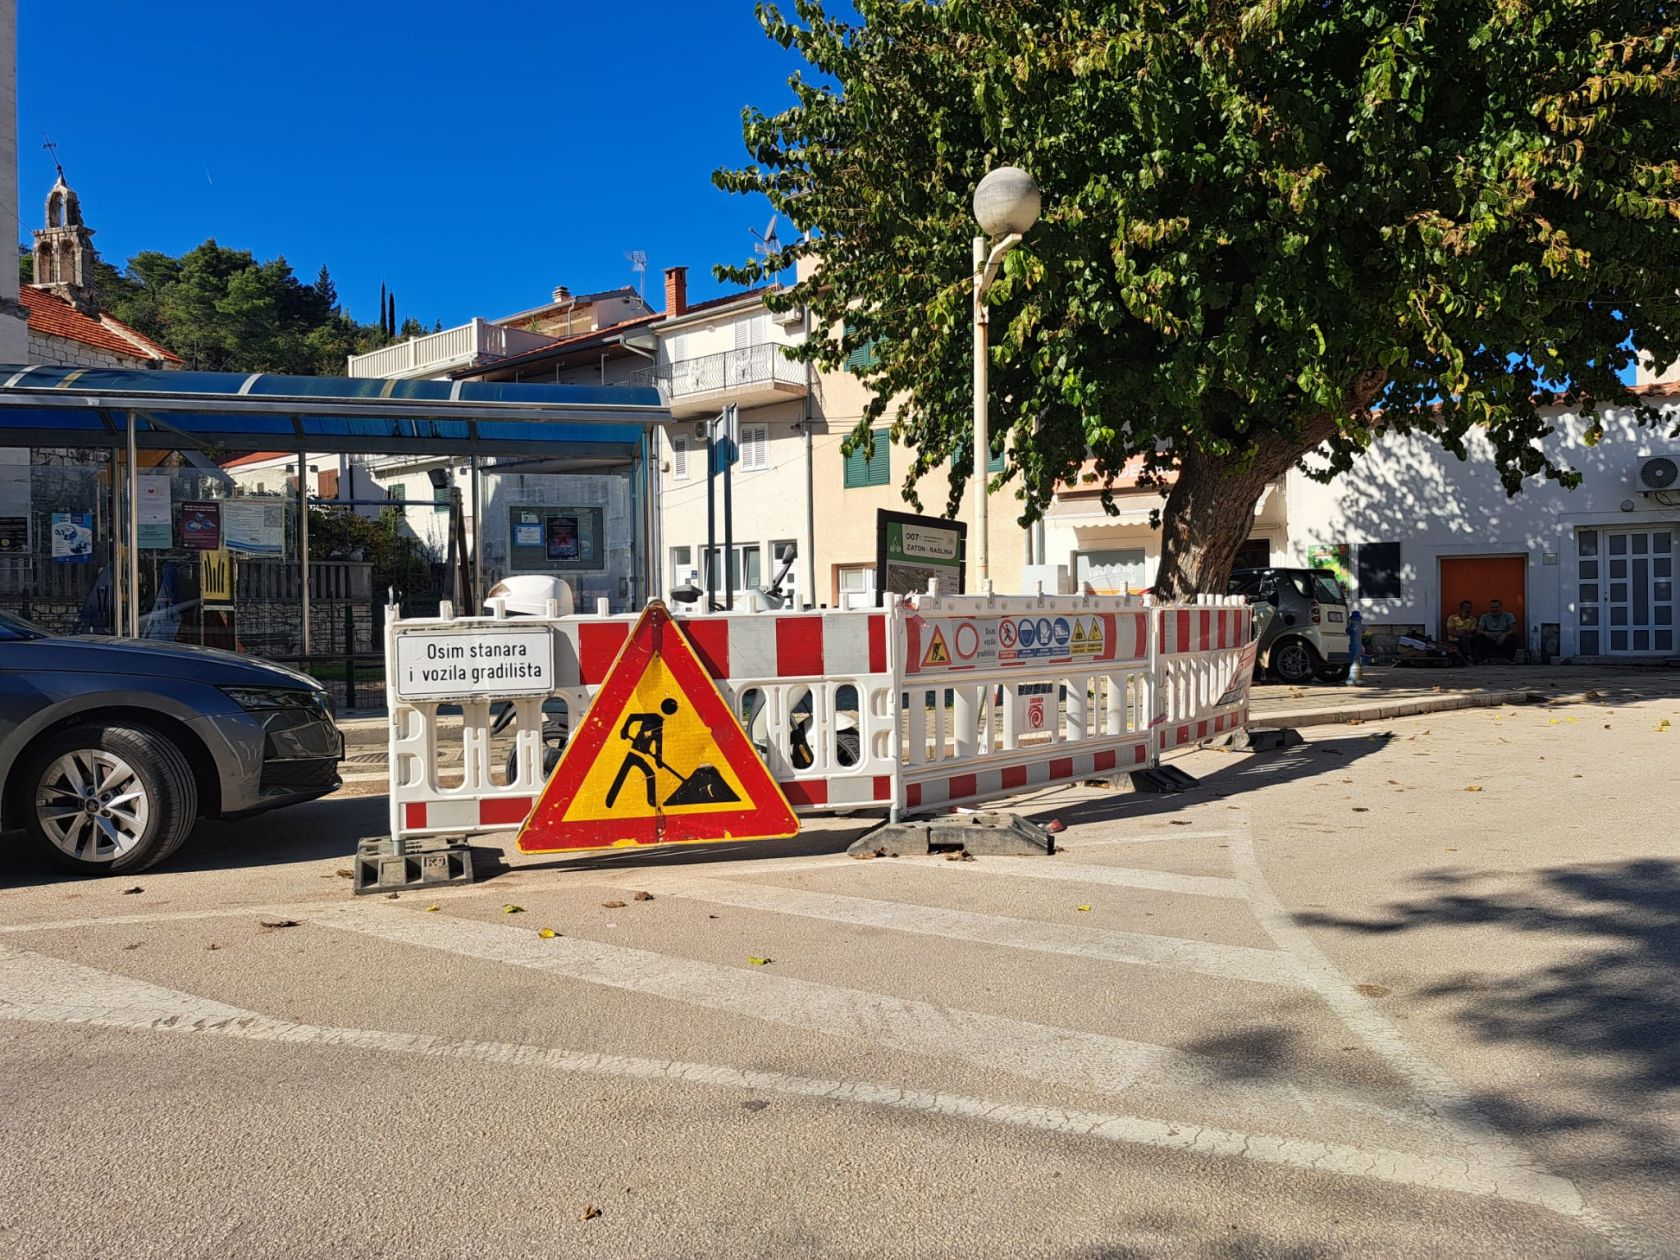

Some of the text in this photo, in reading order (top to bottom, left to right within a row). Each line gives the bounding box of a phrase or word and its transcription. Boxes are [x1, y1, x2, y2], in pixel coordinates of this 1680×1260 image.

[906, 532, 919, 540] 007
[906, 544, 926, 552] ZATON
[427, 642, 527, 660] Osim stanara
[409, 662, 542, 684] i vozila gradilišta
